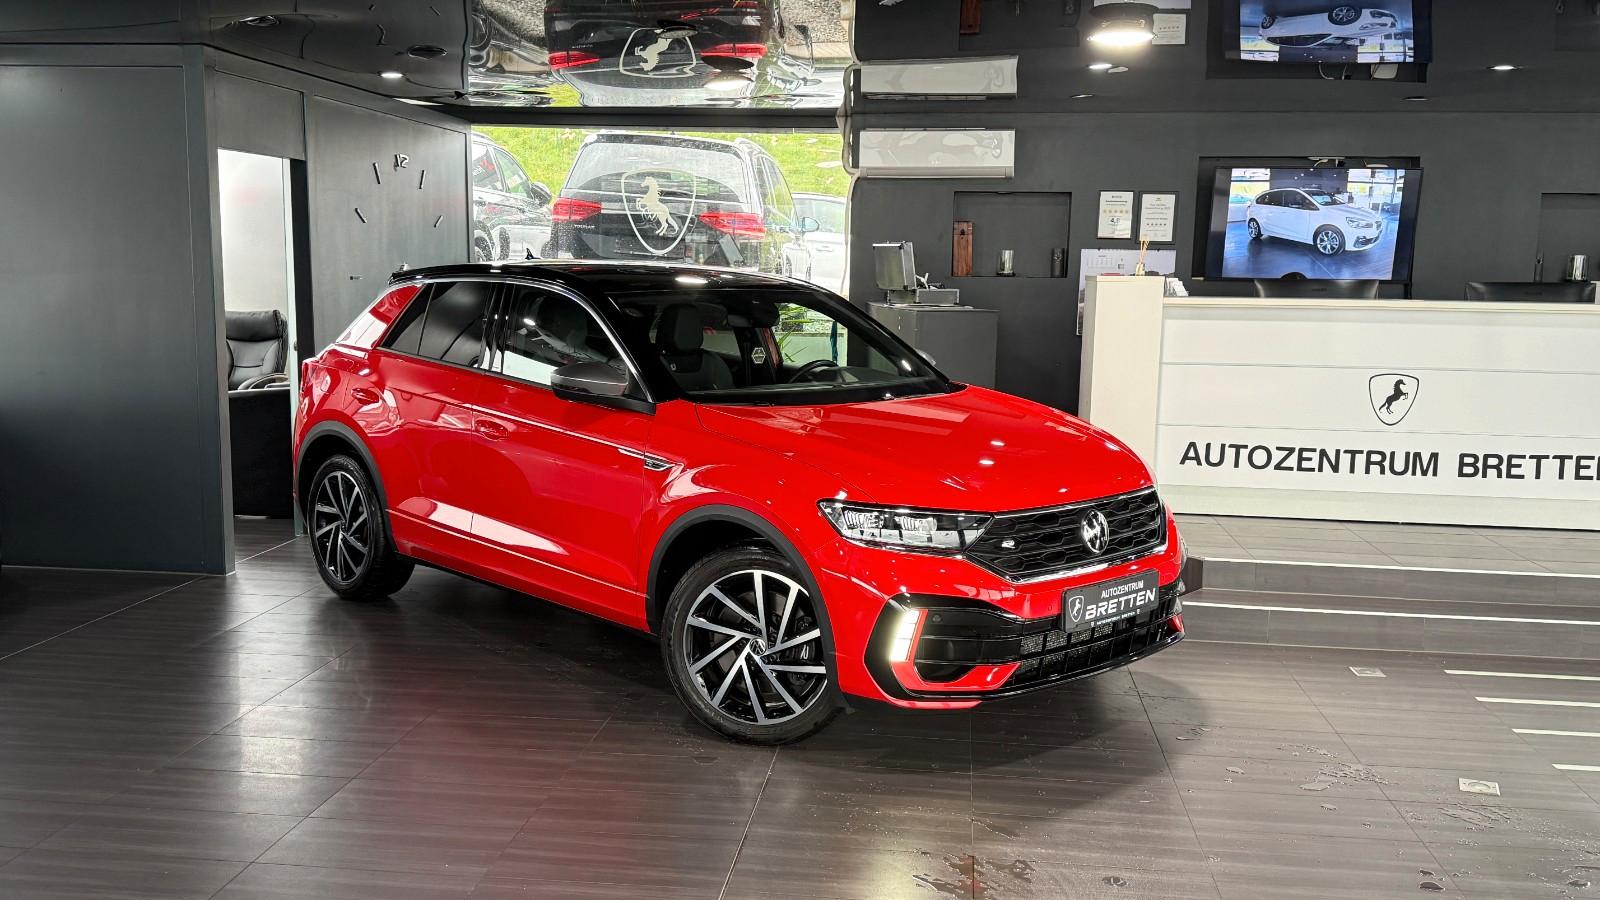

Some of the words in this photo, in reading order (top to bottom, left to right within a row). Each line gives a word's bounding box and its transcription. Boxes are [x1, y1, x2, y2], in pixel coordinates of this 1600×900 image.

[394, 154, 409, 169] 12
[1179, 441, 1440, 477] AUTOZENTRUM
[1457, 453, 1600, 481] BRETTE
[1101, 580, 1144, 599] AUTOZENTRUM
[1085, 588, 1156, 620] BRETTEN
